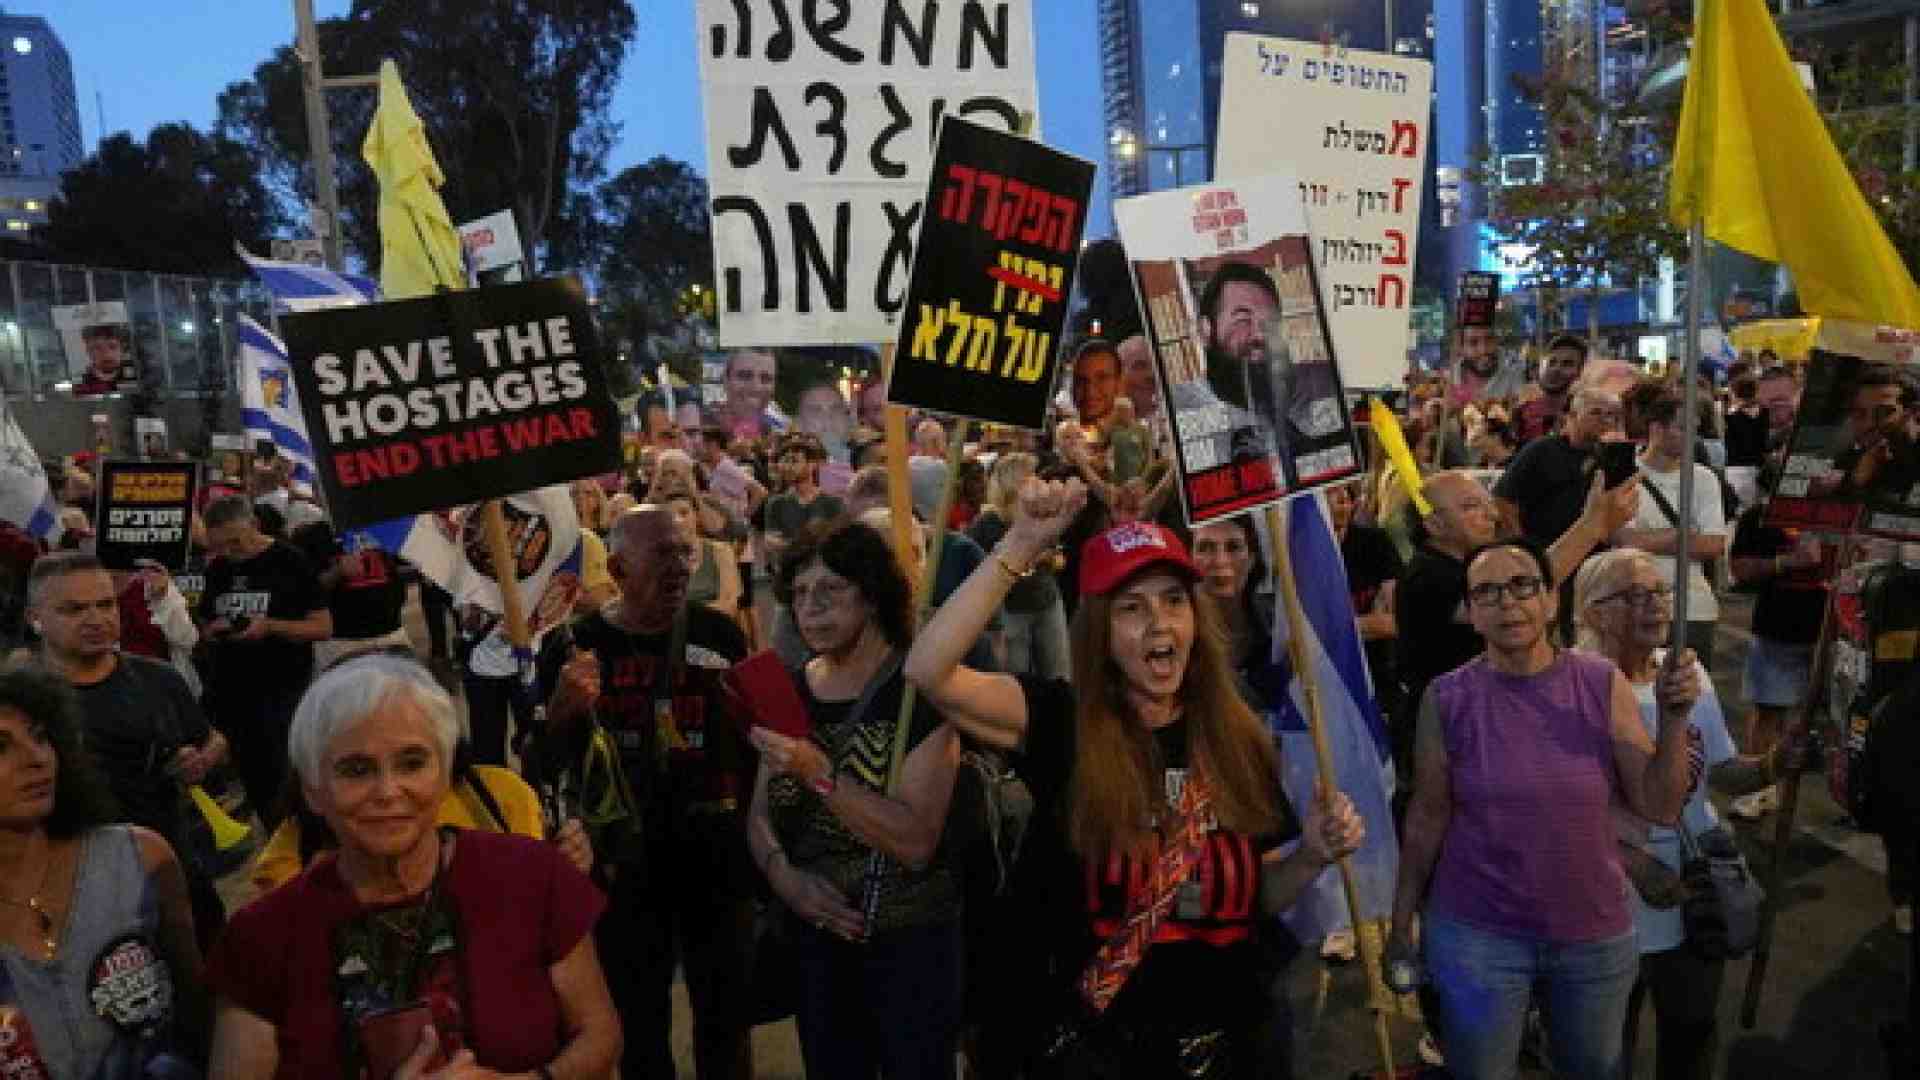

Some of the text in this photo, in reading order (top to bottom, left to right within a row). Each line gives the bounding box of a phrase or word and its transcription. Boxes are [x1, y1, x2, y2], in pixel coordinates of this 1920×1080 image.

[938, 164, 1078, 254] הפקרה
[313, 315, 577, 396] SAVE THE
[911, 297, 1050, 382] על מלא
[321, 359, 588, 445] HOSTAGES
[335, 406, 599, 488] END THE WAR
